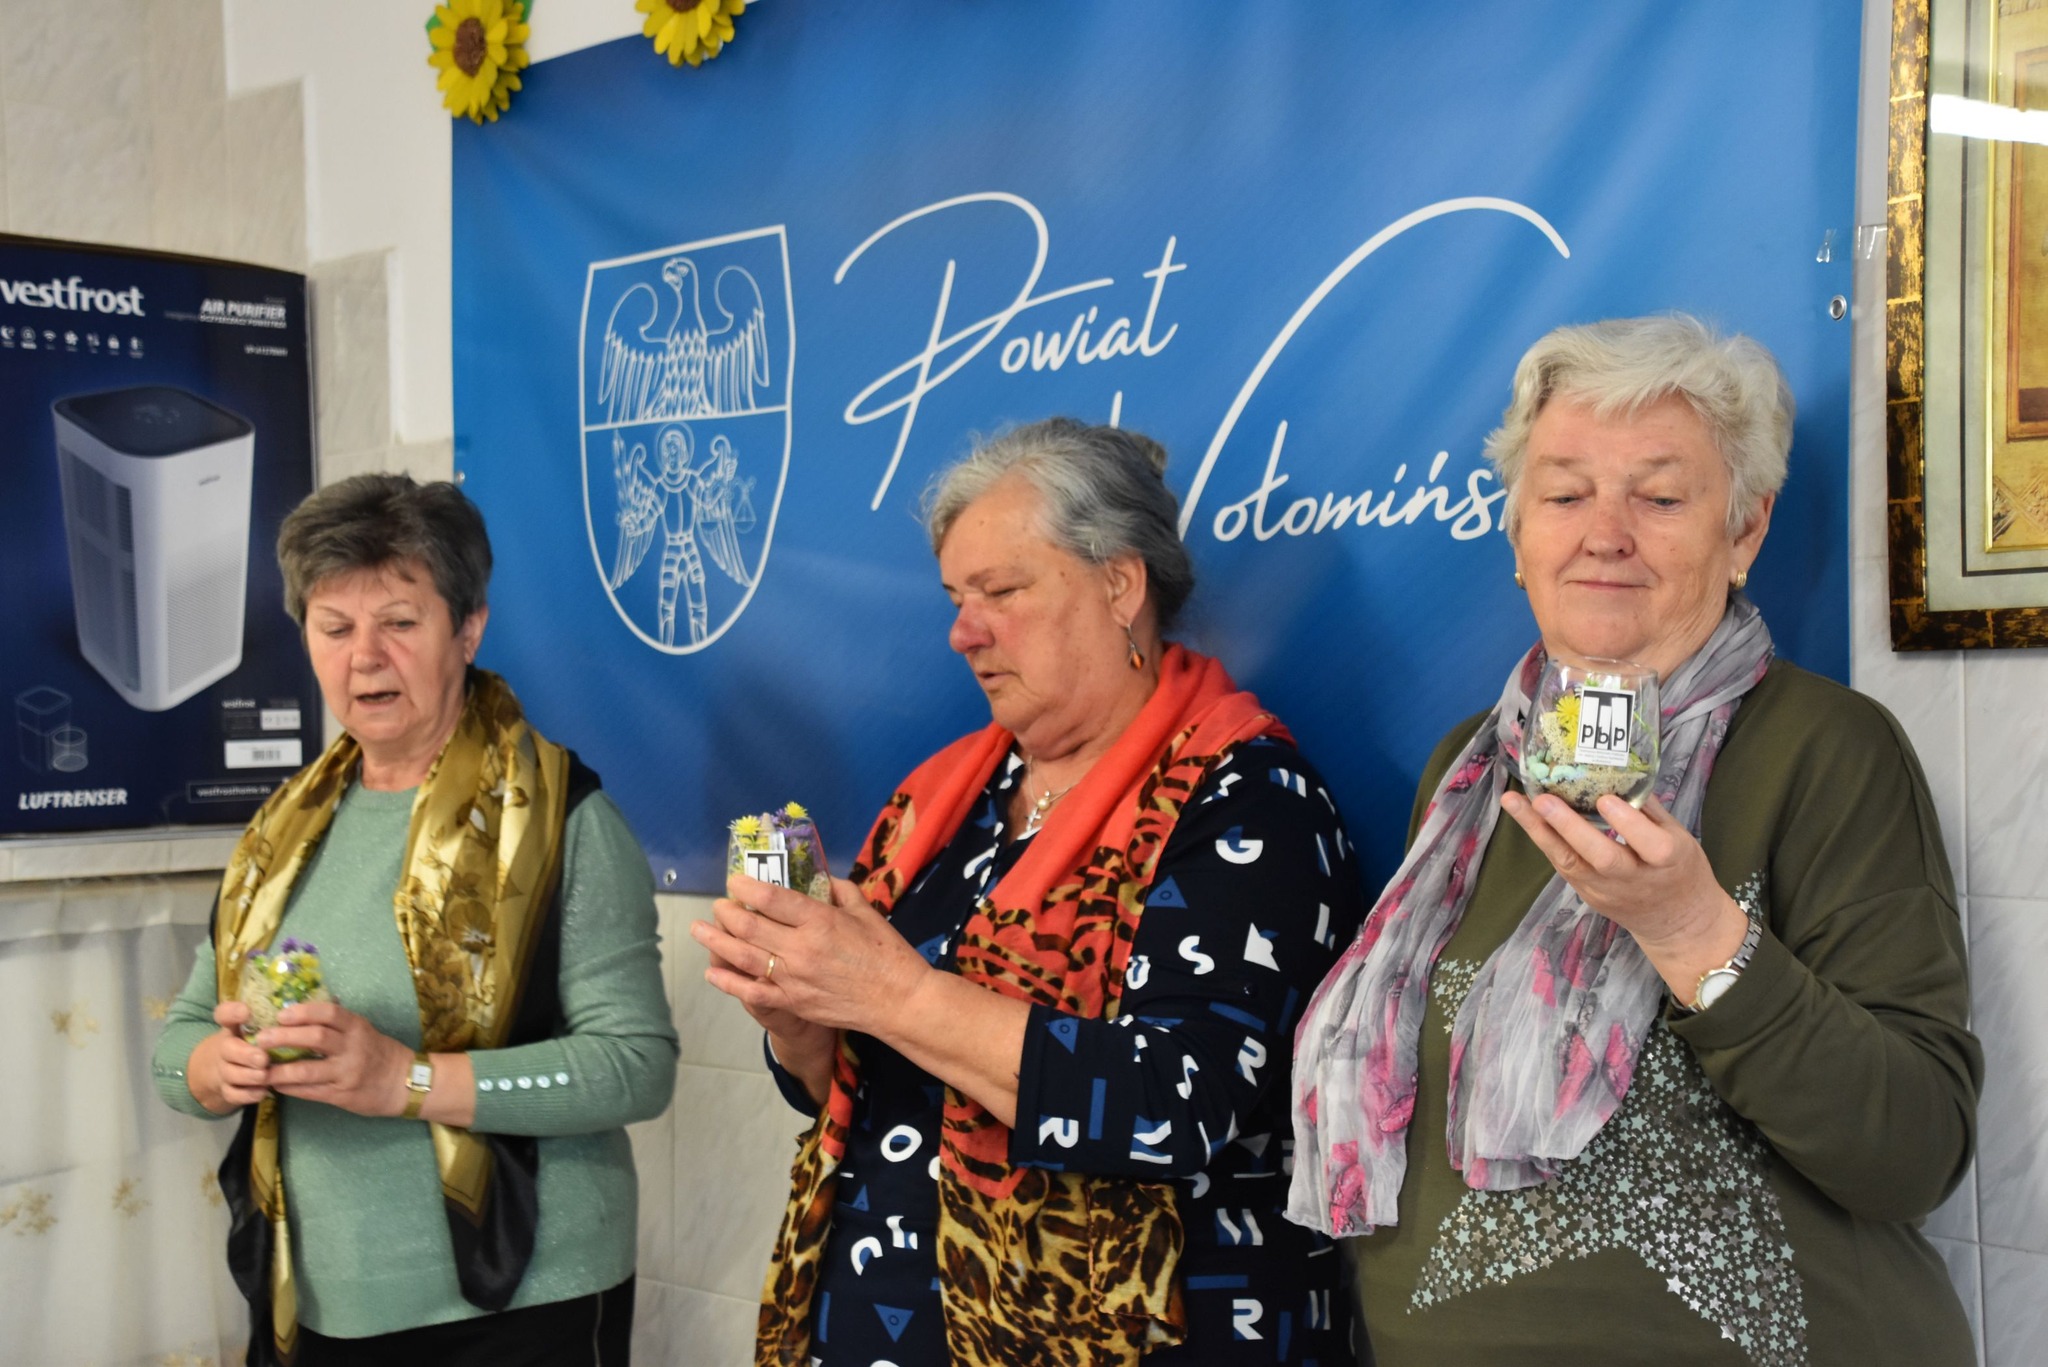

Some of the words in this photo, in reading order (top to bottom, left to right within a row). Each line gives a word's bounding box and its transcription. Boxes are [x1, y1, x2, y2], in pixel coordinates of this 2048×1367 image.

[0, 275, 145, 317] vestfrost
[201, 298, 225, 315] AIR
[227, 301, 287, 320] PURIFIER
[834, 191, 1187, 511] Powiat
[18, 788, 128, 810] LUFTRENSER
[1233, 1299, 1264, 1340] R
